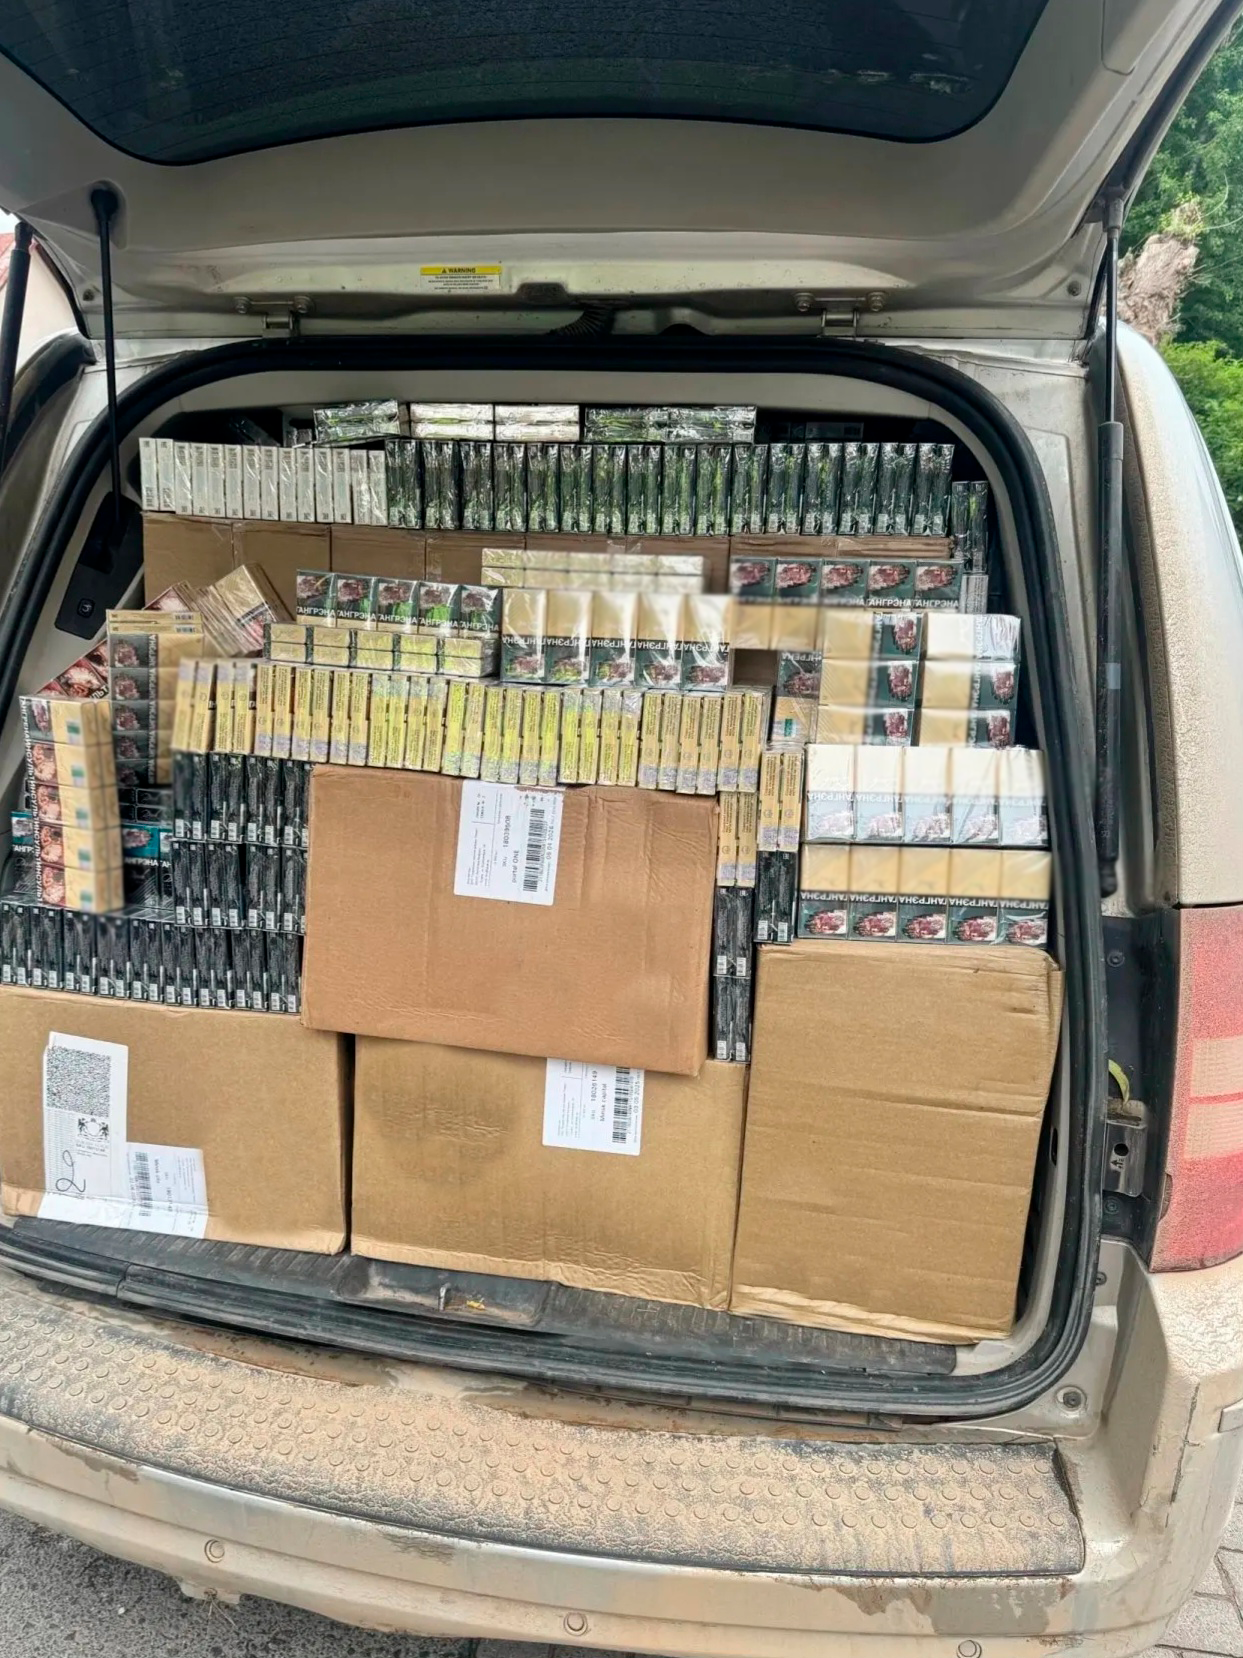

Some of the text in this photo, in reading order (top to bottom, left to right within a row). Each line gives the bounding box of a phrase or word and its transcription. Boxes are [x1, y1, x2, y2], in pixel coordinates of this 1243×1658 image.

[800, 891, 848, 901] ГАНГРЭНА
[850, 893, 898, 904] ГАНГРЭНА
[899, 895, 948, 905] ГАНГРЭНА
[949, 897, 999, 908] ГАНГРЭНА
[999, 900, 1049, 910] ГАНГРЭНА
